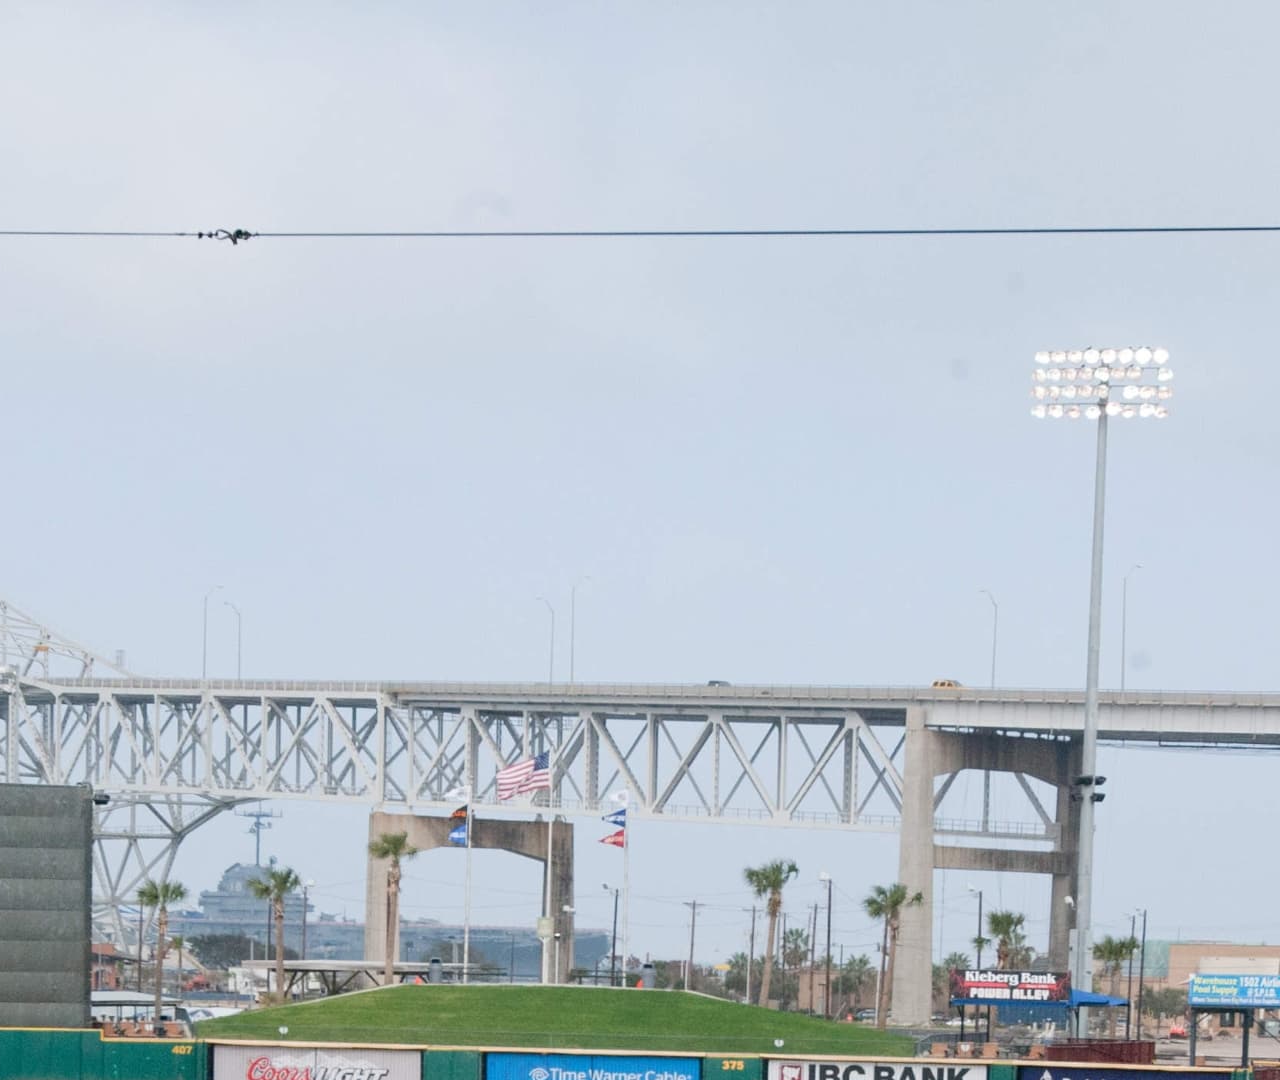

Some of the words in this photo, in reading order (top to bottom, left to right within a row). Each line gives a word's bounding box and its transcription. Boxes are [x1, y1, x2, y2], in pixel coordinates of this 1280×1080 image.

[965, 971, 1019, 985] Kleberg
[1021, 973, 1056, 984] Bank
[1194, 977, 1237, 985] Warehouse
[1240, 977, 1259, 988] 1502
[970, 987, 1010, 999] POWER
[1012, 988, 1050, 1000] ALLEY
[172, 1045, 193, 1055] 407
[722, 1060, 744, 1070] 375
